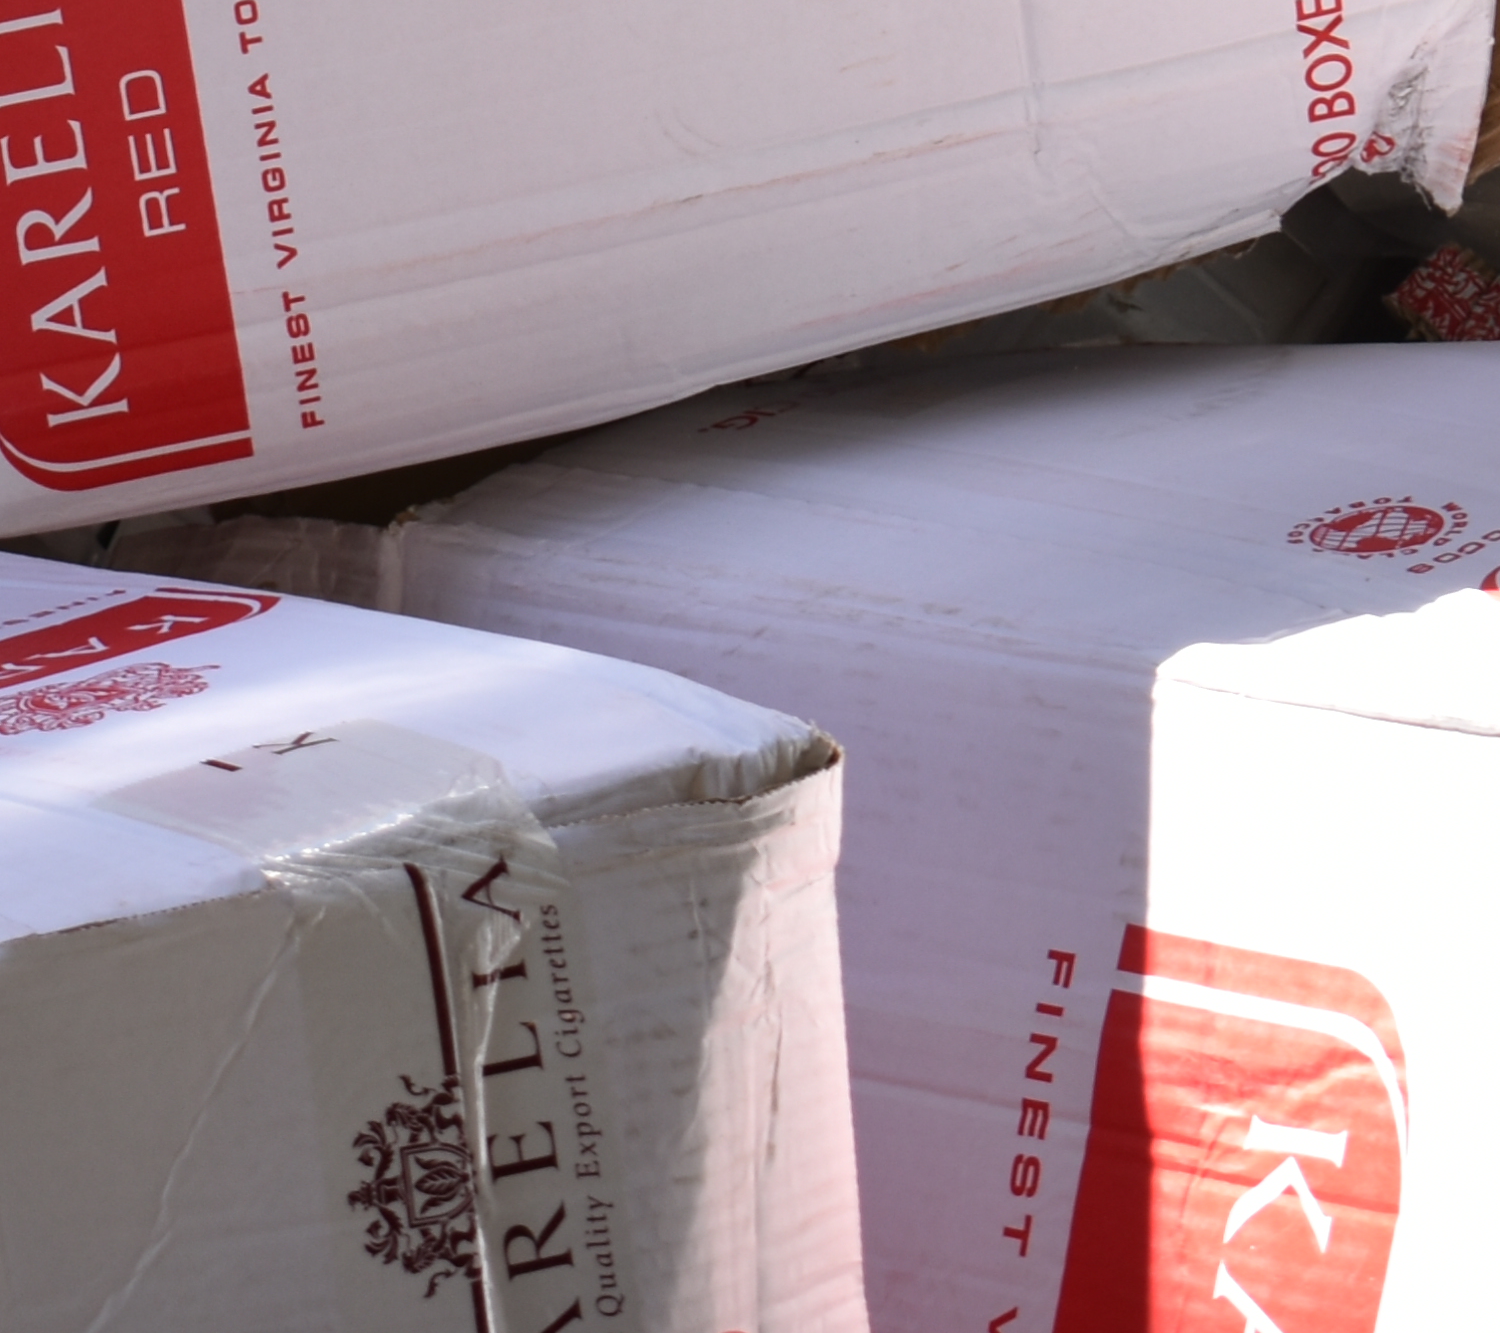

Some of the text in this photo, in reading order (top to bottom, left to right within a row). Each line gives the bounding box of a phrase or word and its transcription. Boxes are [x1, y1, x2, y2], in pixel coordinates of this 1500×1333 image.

[121, 68, 186, 237] RED
[245, 72, 298, 271] VIRGINIA
[282, 289, 326, 430] FINEST
[539, 903, 626, 1318] Quality Export Cigarettes
[1002, 948, 1077, 1258] FINEST
